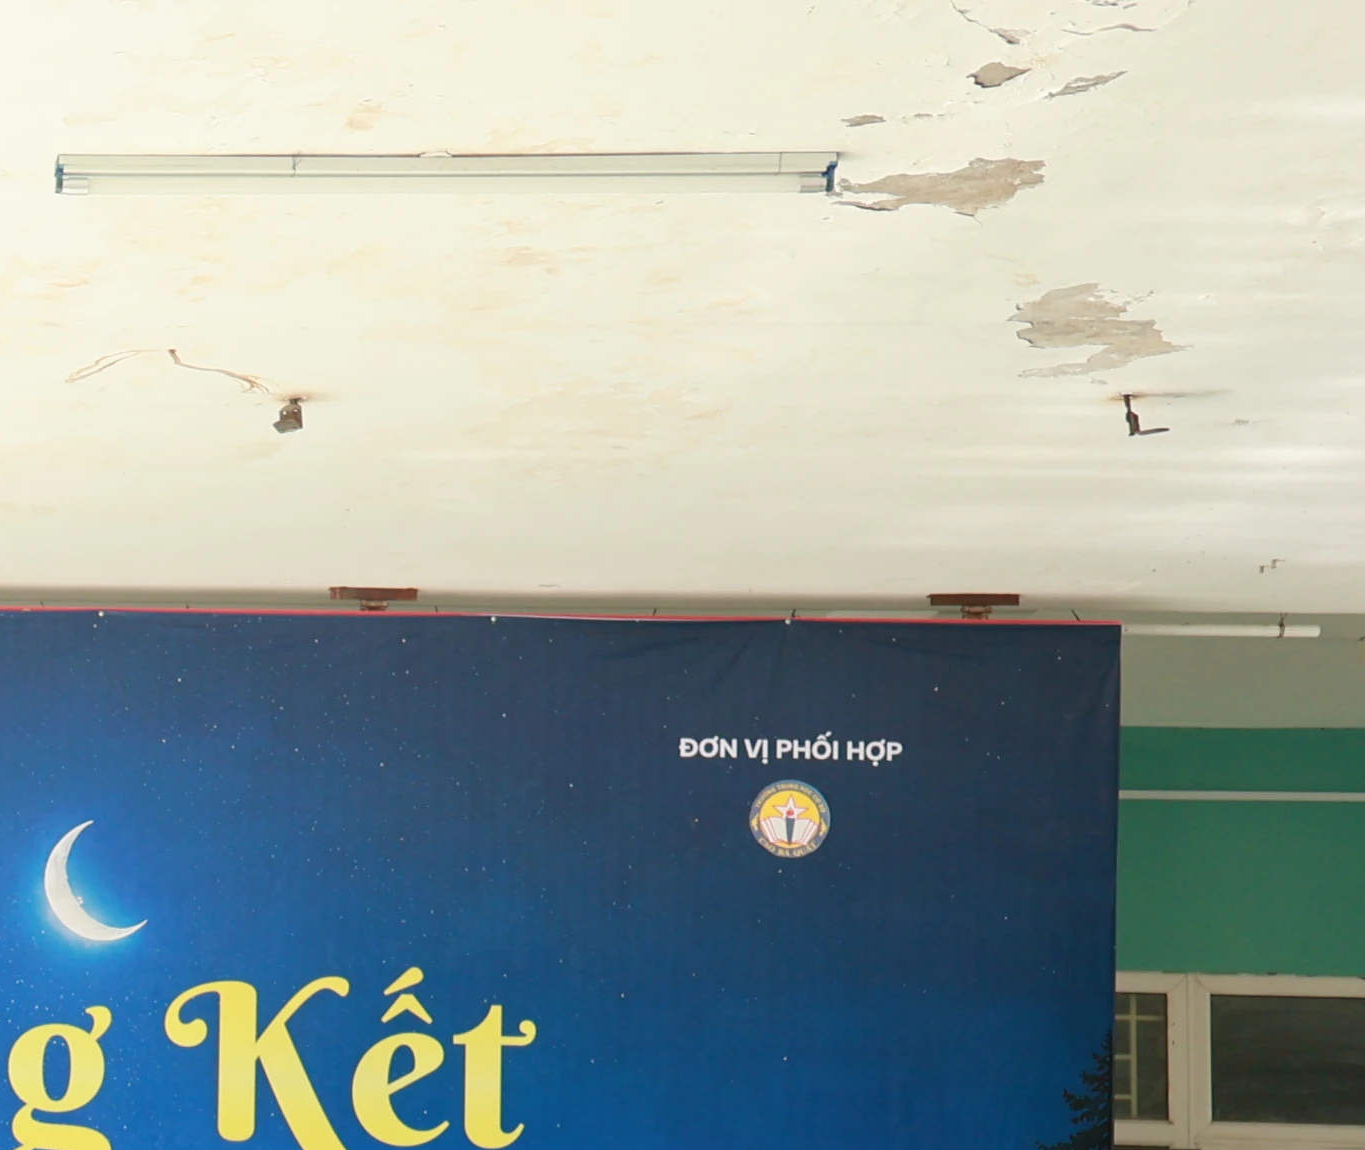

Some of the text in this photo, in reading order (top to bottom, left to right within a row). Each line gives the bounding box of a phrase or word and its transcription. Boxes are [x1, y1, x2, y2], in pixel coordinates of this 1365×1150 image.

[678, 731, 903, 767] ĐƠN VỊ PHỐI HỢP
